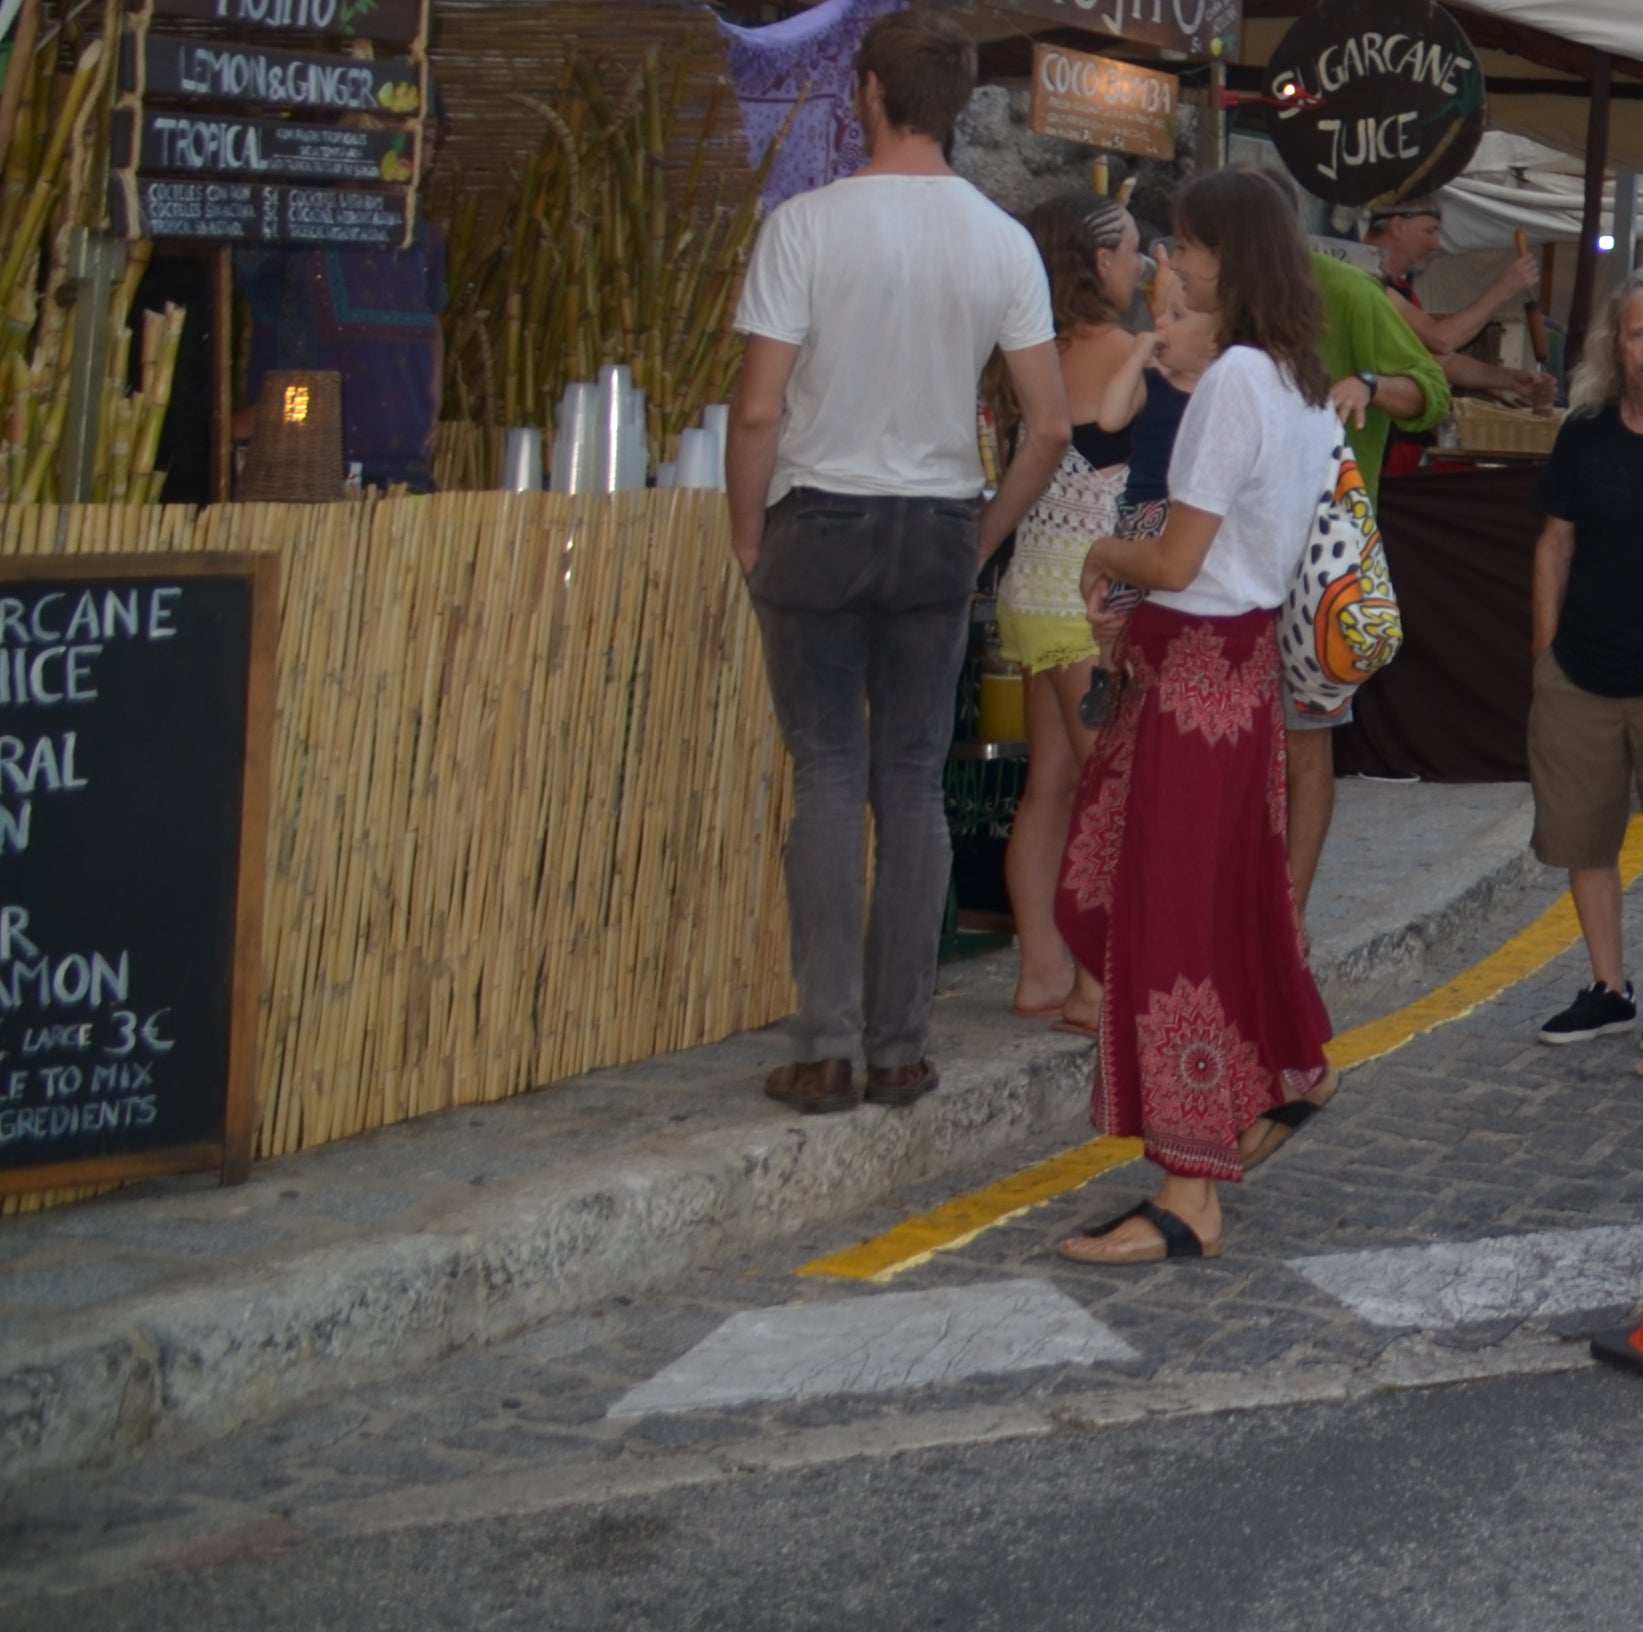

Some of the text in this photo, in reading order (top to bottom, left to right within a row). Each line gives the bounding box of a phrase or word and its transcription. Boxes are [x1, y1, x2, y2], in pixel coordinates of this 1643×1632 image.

[1042, 53, 1171, 113] COCO BOMBA
[1272, 32, 1472, 119] SUGARCANE
[154, 118, 268, 169] TROPICAL
[1317, 111, 1419, 180] JUICE
[0, 587, 183, 643] RCANE
[0, 731, 88, 793] RAL
[22, 1007, 176, 1055] LARGE 3€
[40, 1065, 83, 1098] TO
[90, 1062, 153, 1093] MIX
[0, 1095, 157, 1144] GREDIENTS
